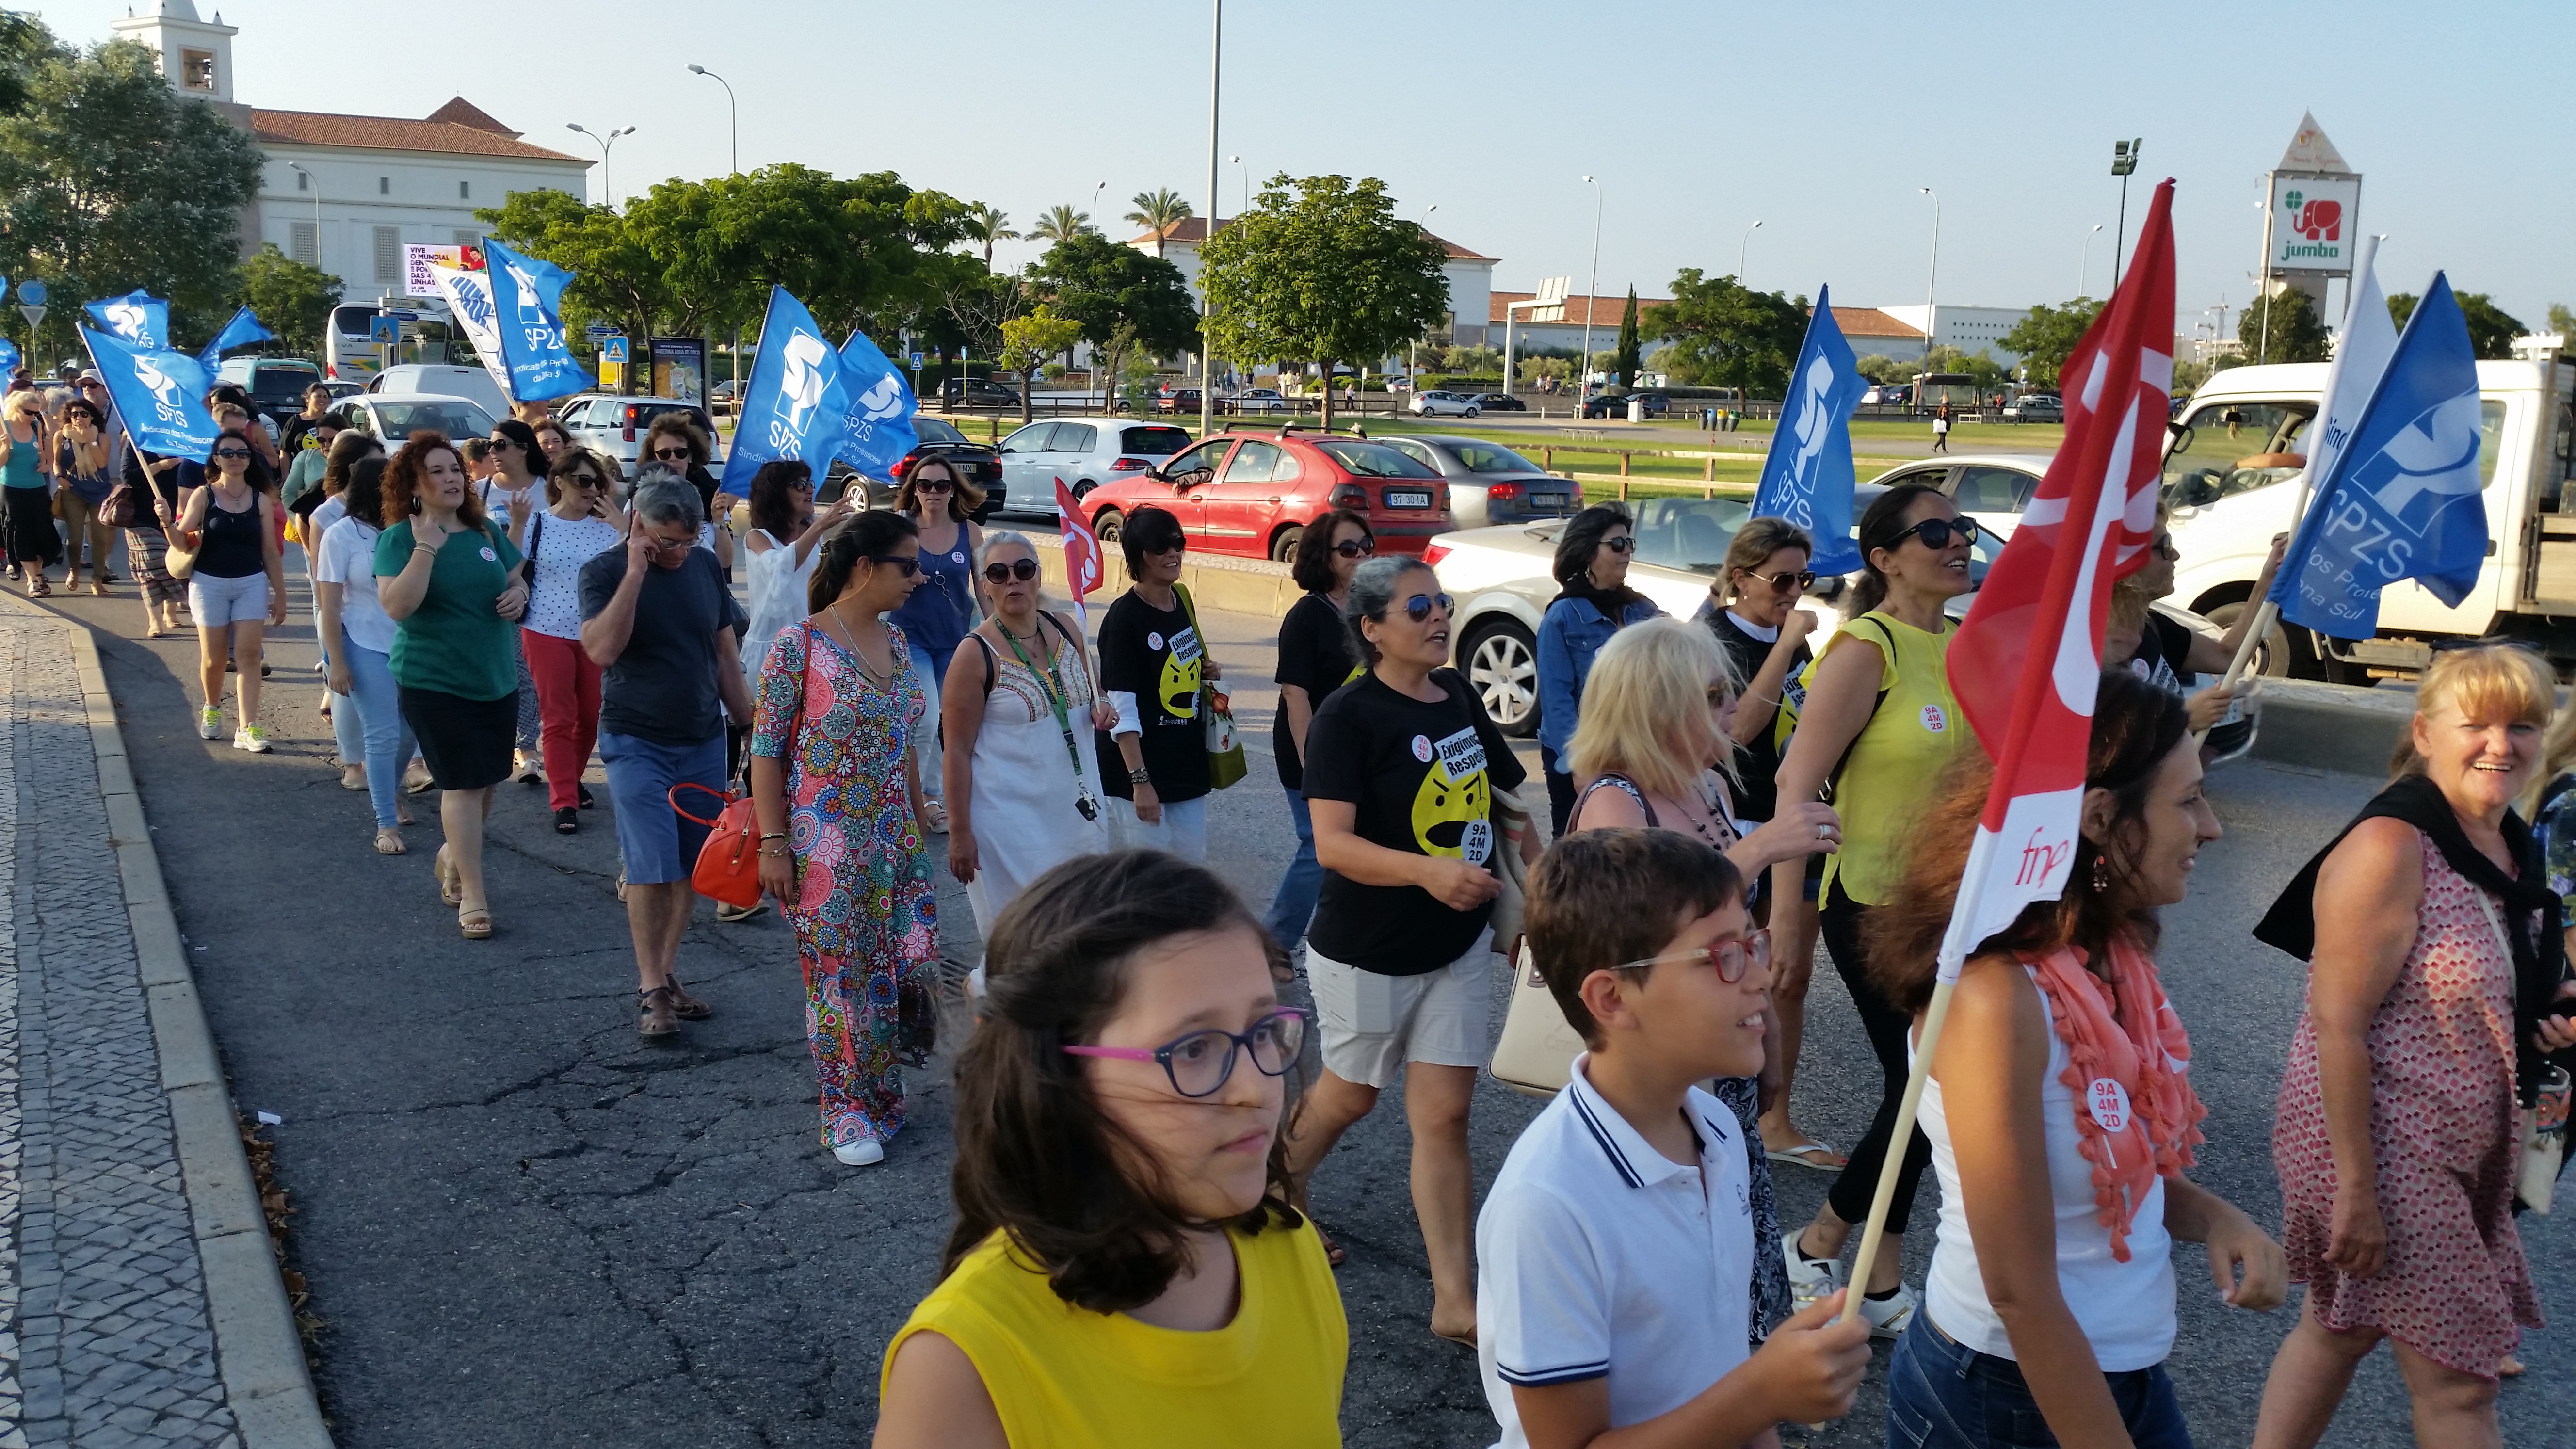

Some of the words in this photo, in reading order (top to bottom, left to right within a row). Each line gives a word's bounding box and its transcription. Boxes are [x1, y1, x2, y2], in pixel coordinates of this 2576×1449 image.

[2281, 241, 2338, 260] jumbo
[849, 455, 861, 465] Sul
[2329, 603, 2365, 620] Sul
[1931, 722, 1942, 730] 2D
[1418, 751, 1427, 759] 2D
[1472, 824, 1486, 836] 9A
[1469, 837, 1485, 849] 4M
[1468, 850, 1482, 861] 2D
[2095, 1082, 2117, 1096] 9A
[2098, 1098, 2120, 1111] 4M
[2103, 1114, 2121, 1127] 2D
